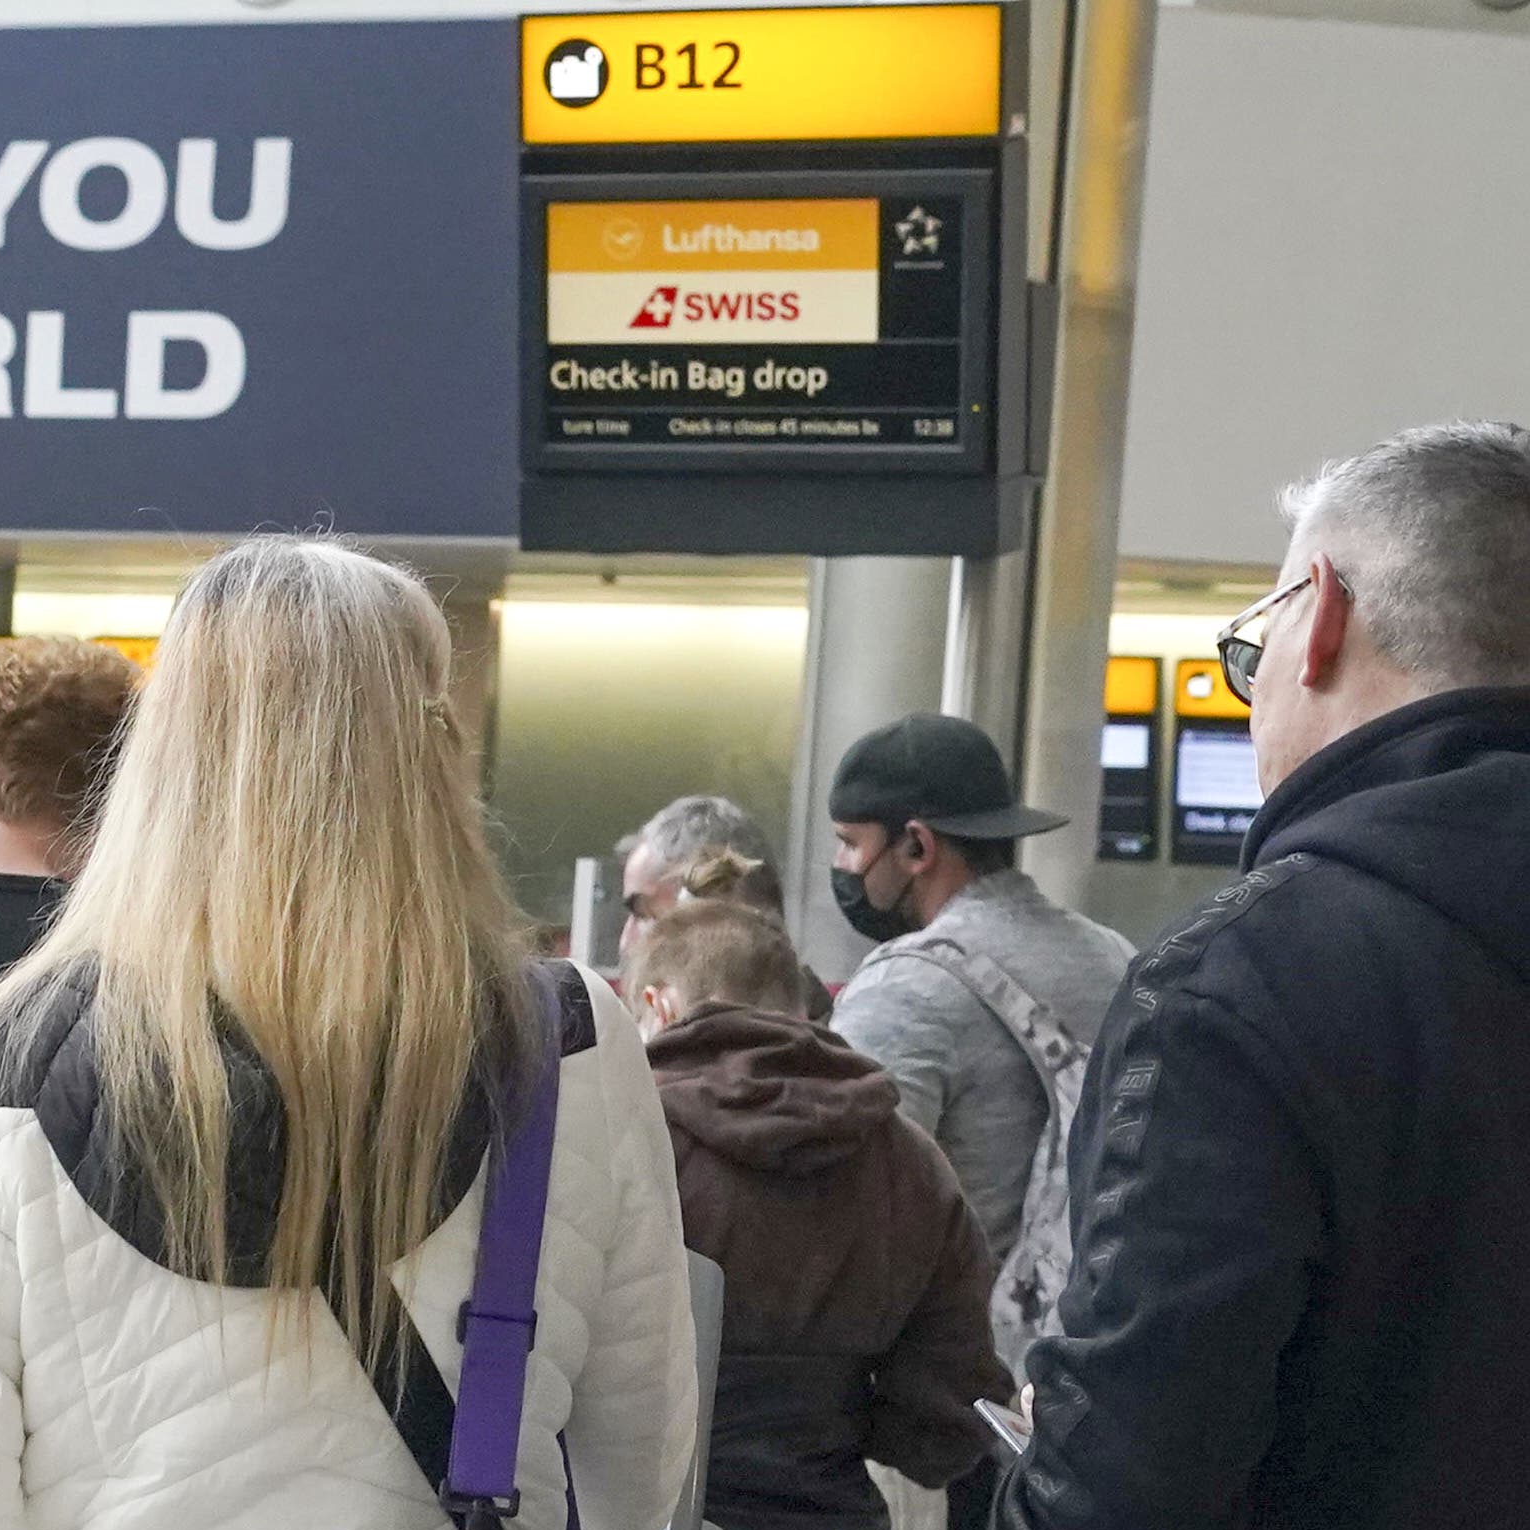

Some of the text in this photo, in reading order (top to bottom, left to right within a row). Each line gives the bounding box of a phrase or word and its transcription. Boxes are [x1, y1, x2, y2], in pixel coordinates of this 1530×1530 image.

[634, 41, 743, 91] B12
[662, 223, 820, 254] Lufthansa
[684, 291, 801, 322] SWISS
[549, 360, 828, 398] Check-in Bag drop
